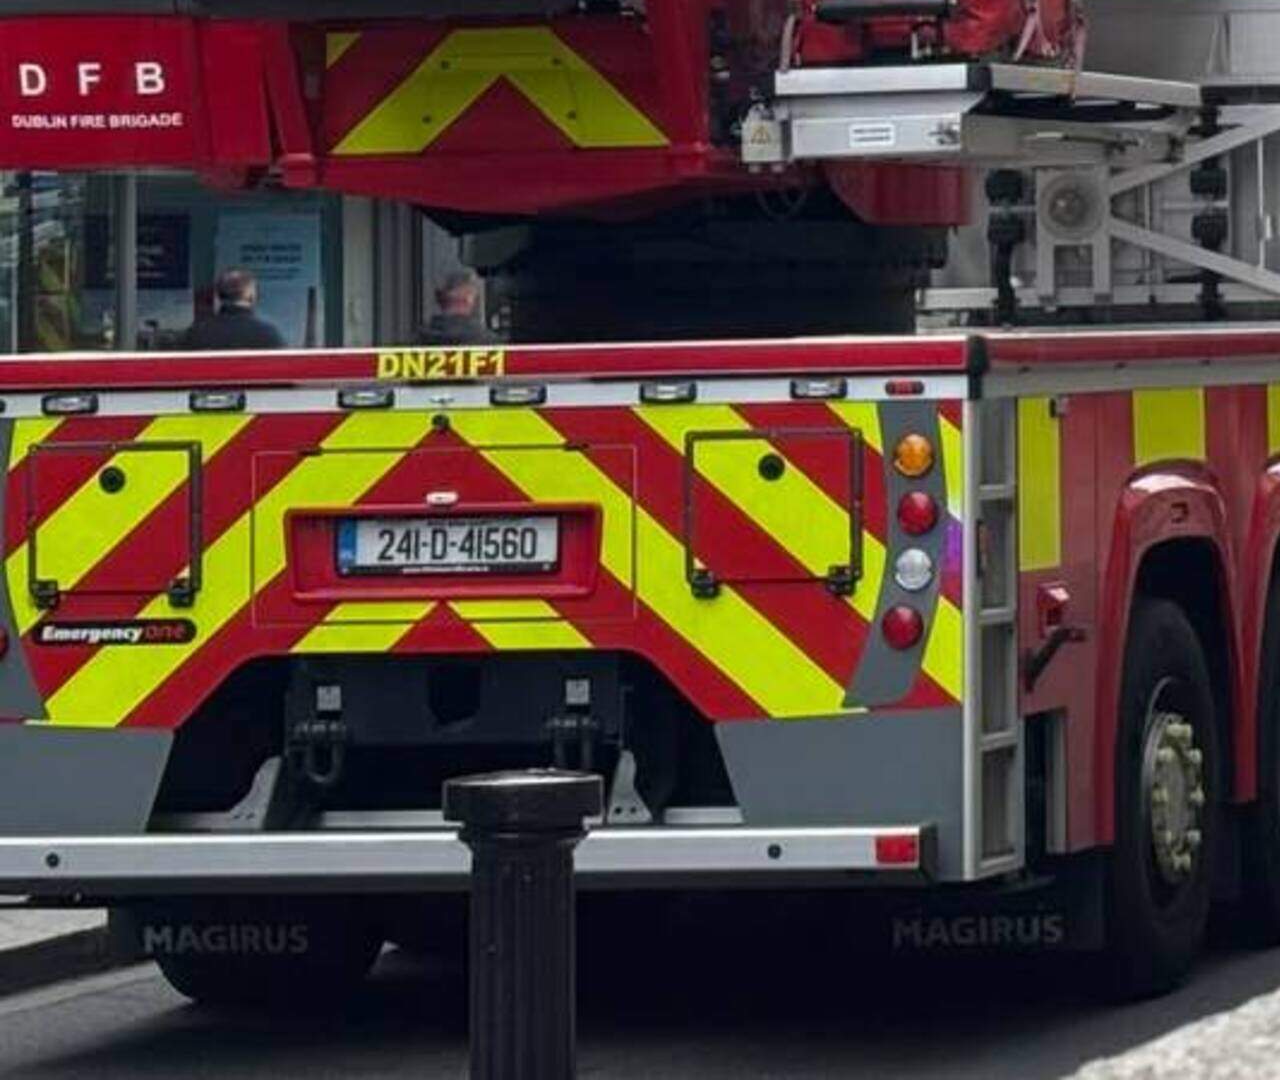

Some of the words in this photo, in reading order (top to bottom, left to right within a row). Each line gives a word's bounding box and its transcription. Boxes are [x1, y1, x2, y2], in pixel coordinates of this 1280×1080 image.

[11, 114, 67, 129] DUBLIN
[70, 114, 106, 128] FIRE
[109, 112, 183, 128] BRIGADE
[378, 350, 505, 378] DN21F1
[377, 528, 537, 561] 241-D-41560
[143, 924, 309, 954] MAGIRUS
[892, 916, 1063, 948] MAGIRUS
